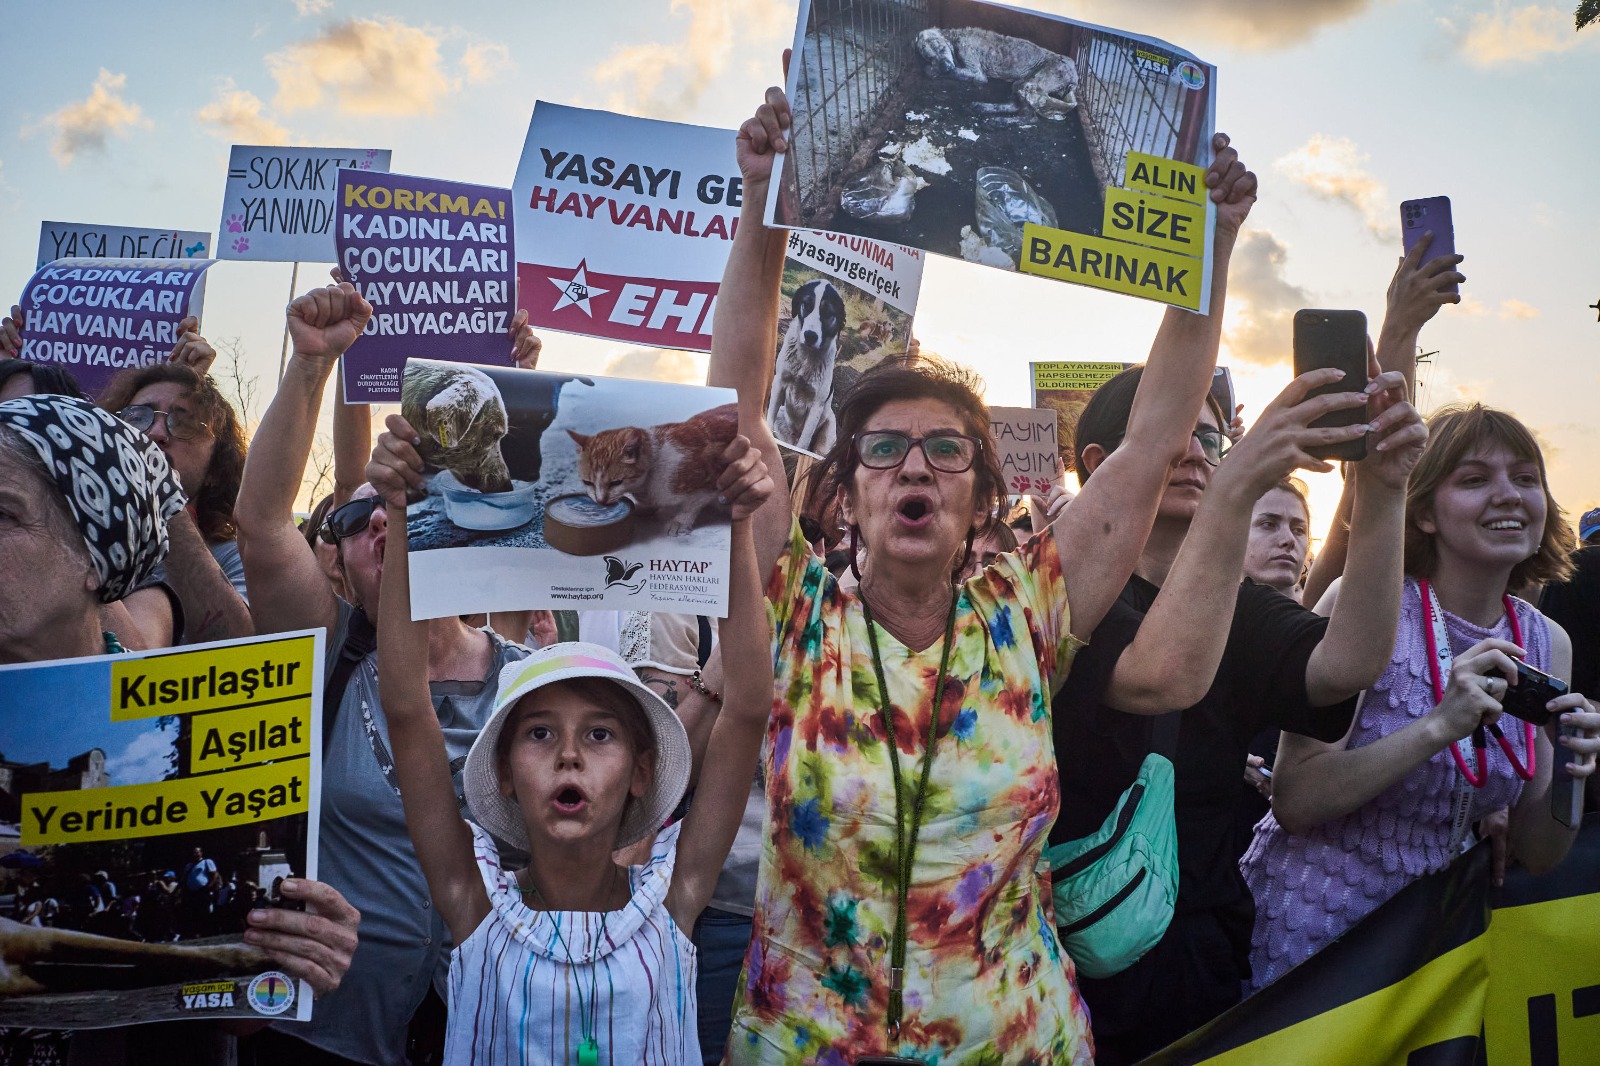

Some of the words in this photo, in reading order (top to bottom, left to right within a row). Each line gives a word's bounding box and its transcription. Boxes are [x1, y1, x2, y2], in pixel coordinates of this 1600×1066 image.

[1136, 57, 1169, 75] YASA
[539, 147, 681, 200] YASAYI
[697, 174, 743, 207] GE
[1130, 162, 1196, 195] ALIN
[344, 184, 506, 220] KORKMA!
[343, 213, 508, 243] KADINLARI
[1111, 199, 1192, 244] SİZE
[41, 268, 194, 286] KADINLARI
[344, 246, 508, 282] ÇOCUKLARI
[788, 231, 901, 299] #yasayıgeriçek
[1029, 236, 1190, 297] BARINAK
[31, 284, 184, 314] ÇOCUKLARI
[25, 310, 179, 344] HAYVANLARI
[360, 307, 508, 336] ORUYACAĞIZ
[649, 573, 683, 582] HAYVAN
[685, 575, 720, 585] HAKLARI
[649, 582, 708, 593] FEDERASYONU
[550, 593, 604, 601] www.haytap.org
[119, 658, 301, 711] Kısırlaştır
[199, 715, 302, 763] Aşılat
[30, 796, 189, 835] Yerinde
[200, 775, 302, 819] Yaşat
[182, 992, 234, 1009] YASA
[183, 984, 216, 994] yaşam
[217, 982, 234, 993] için
